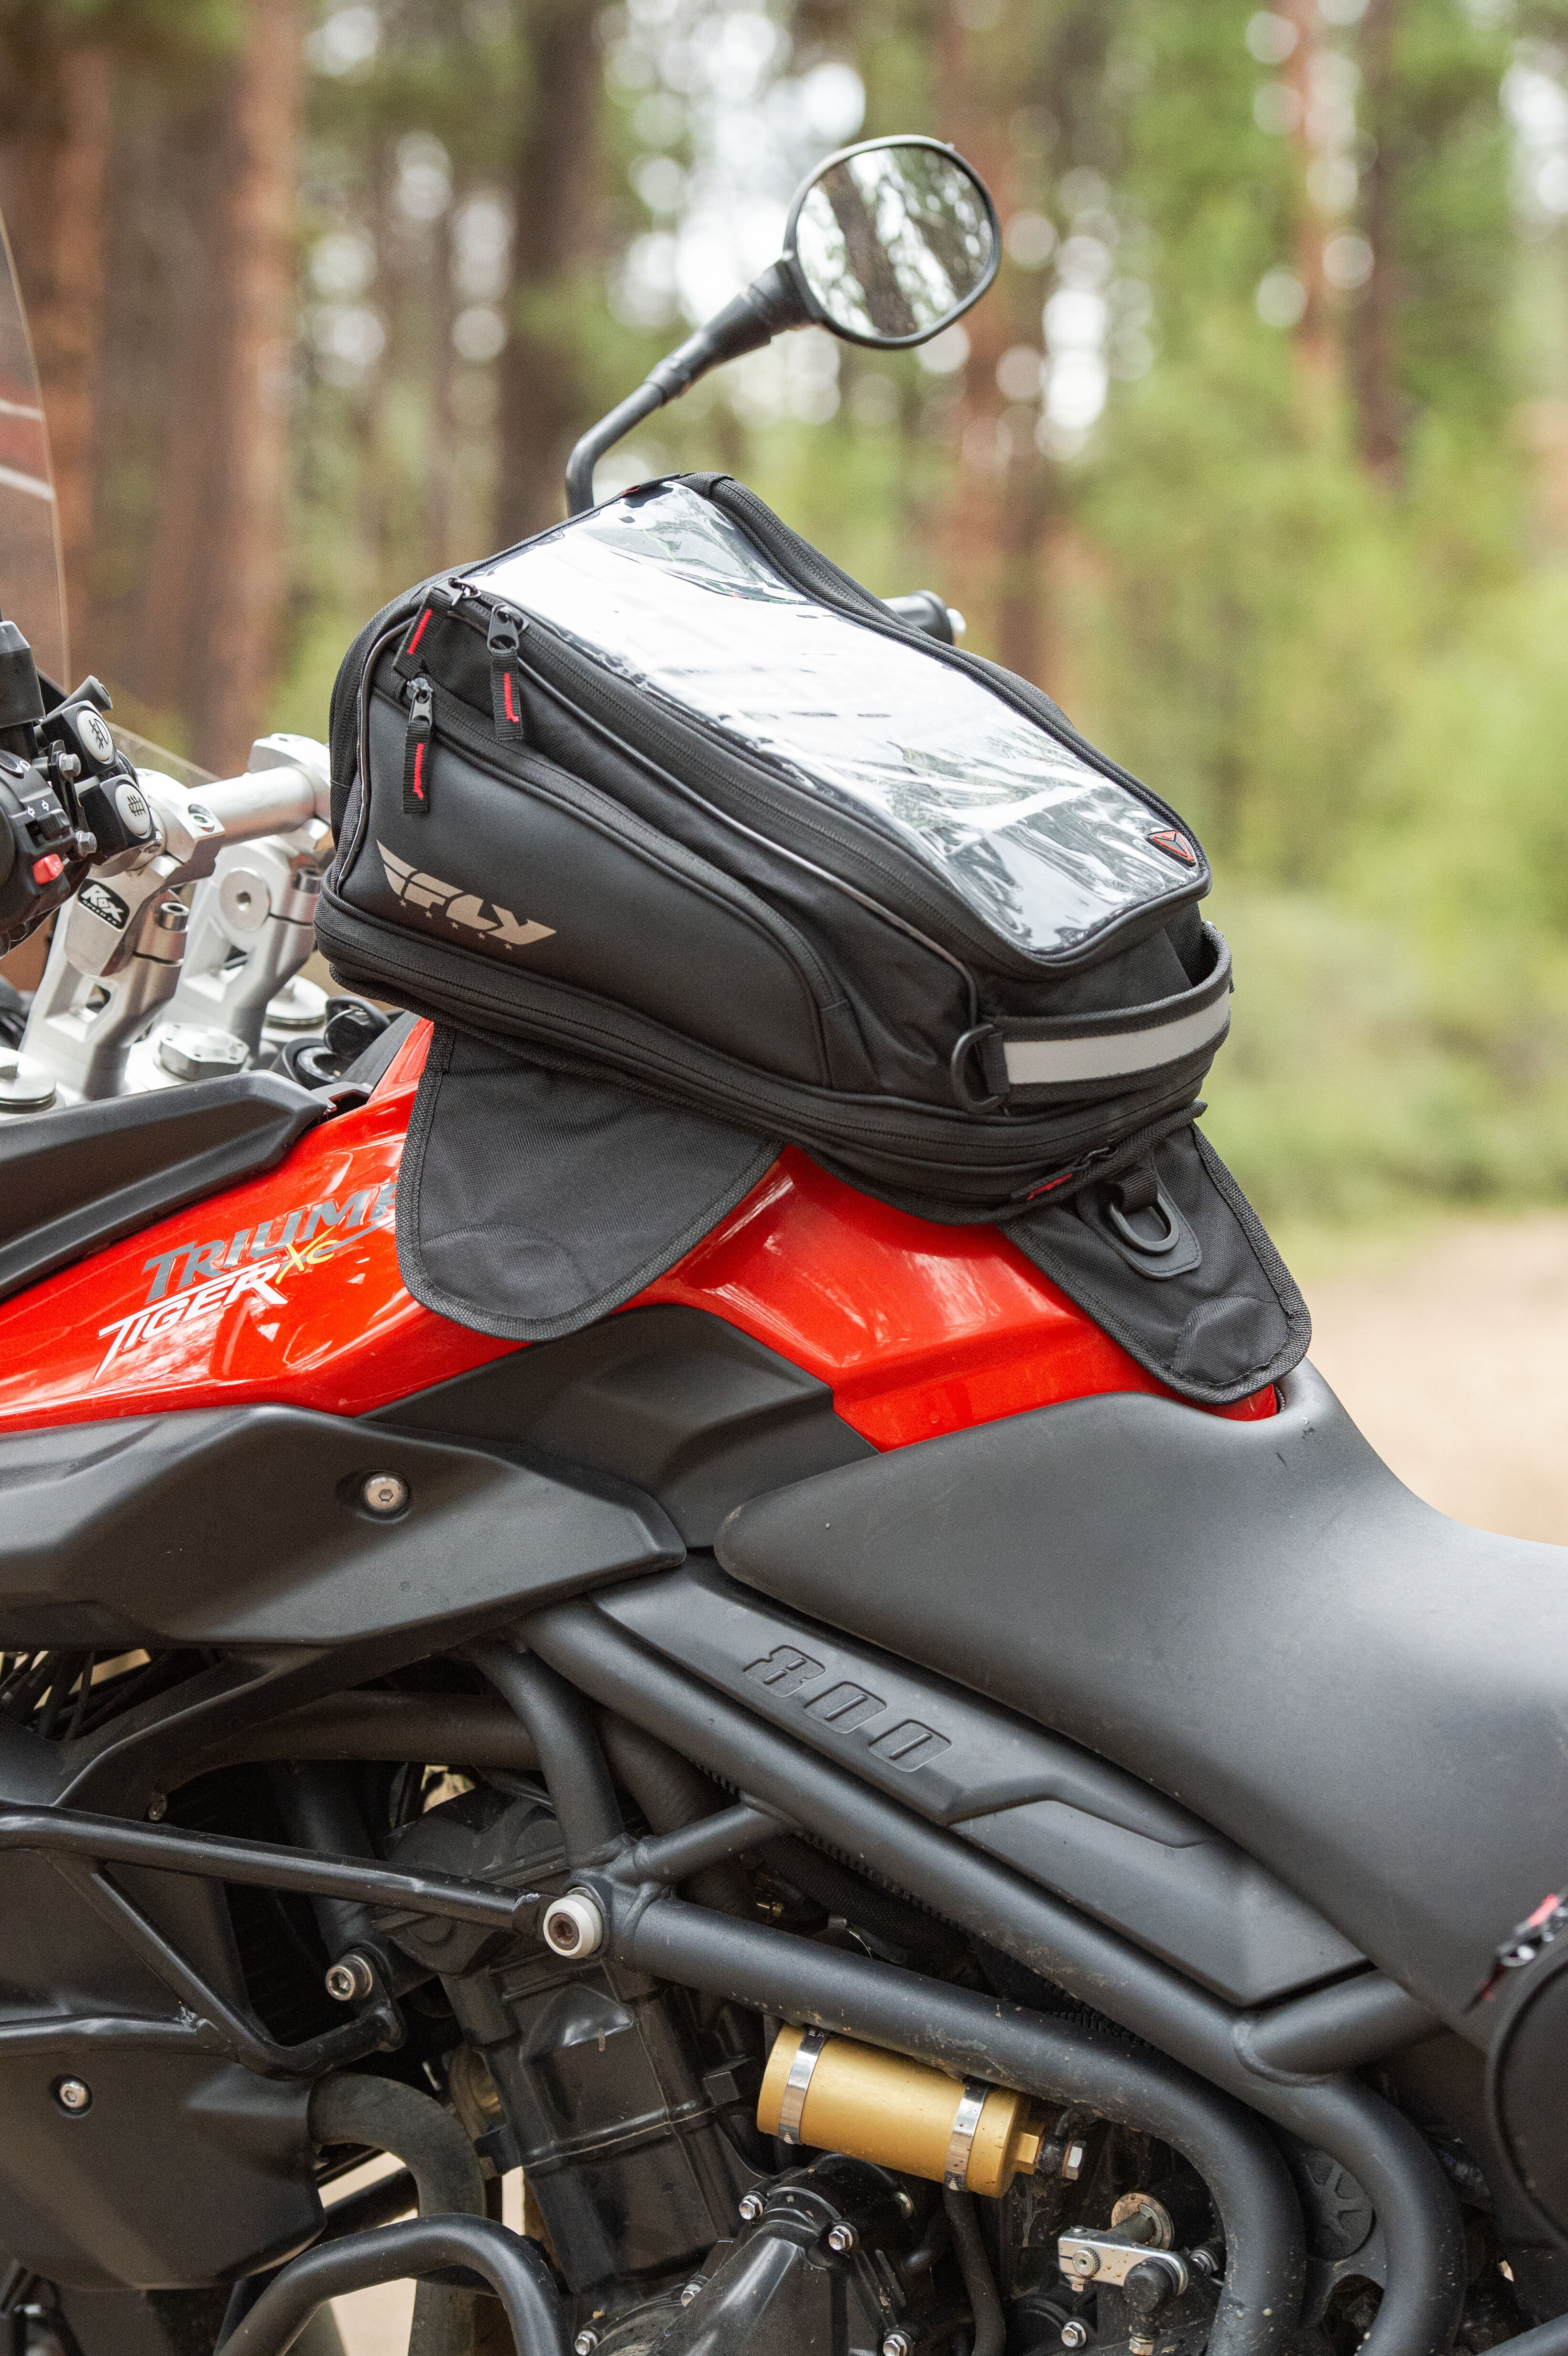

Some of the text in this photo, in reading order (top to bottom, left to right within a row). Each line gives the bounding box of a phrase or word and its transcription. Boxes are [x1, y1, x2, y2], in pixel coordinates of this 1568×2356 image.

[376, 840, 556, 945] FLY
[94, 1225, 337, 1381] TIGER XC
[743, 1645, 952, 1772] 800
